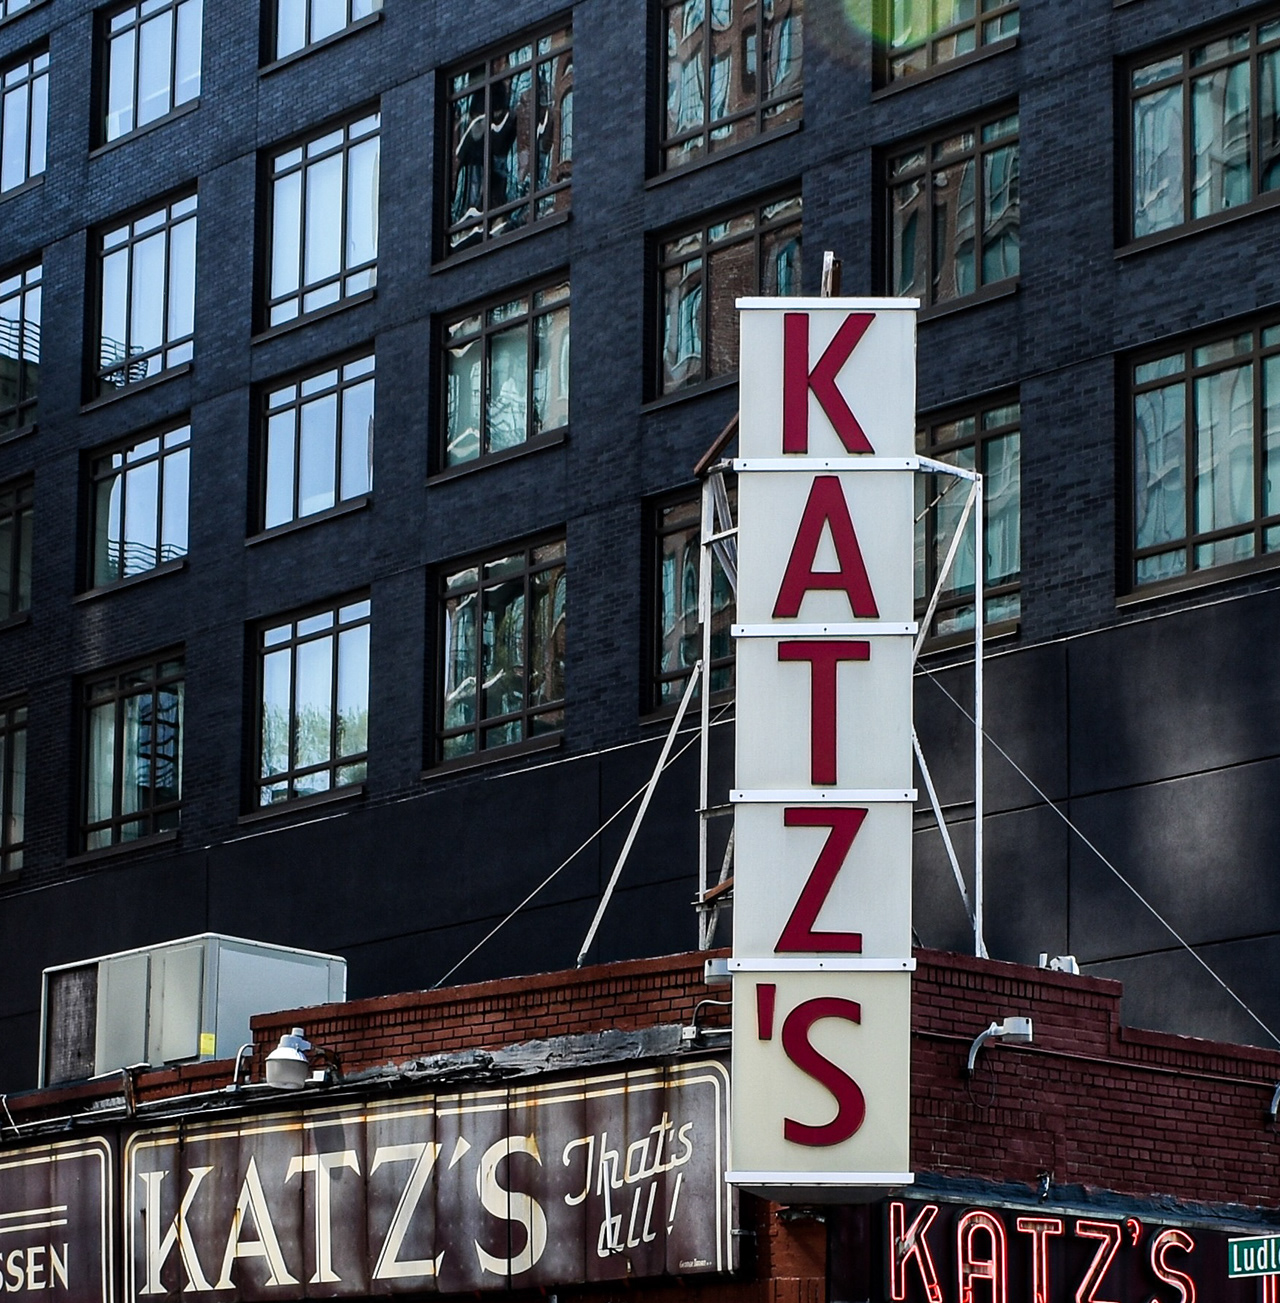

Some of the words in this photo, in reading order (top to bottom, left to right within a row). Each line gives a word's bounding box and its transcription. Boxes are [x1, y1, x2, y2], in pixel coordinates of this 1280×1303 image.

[756, 312, 880, 1147] KATZ'S
[139, 1135, 548, 1295] KATZ'S
[563, 1112, 693, 1205] That's
